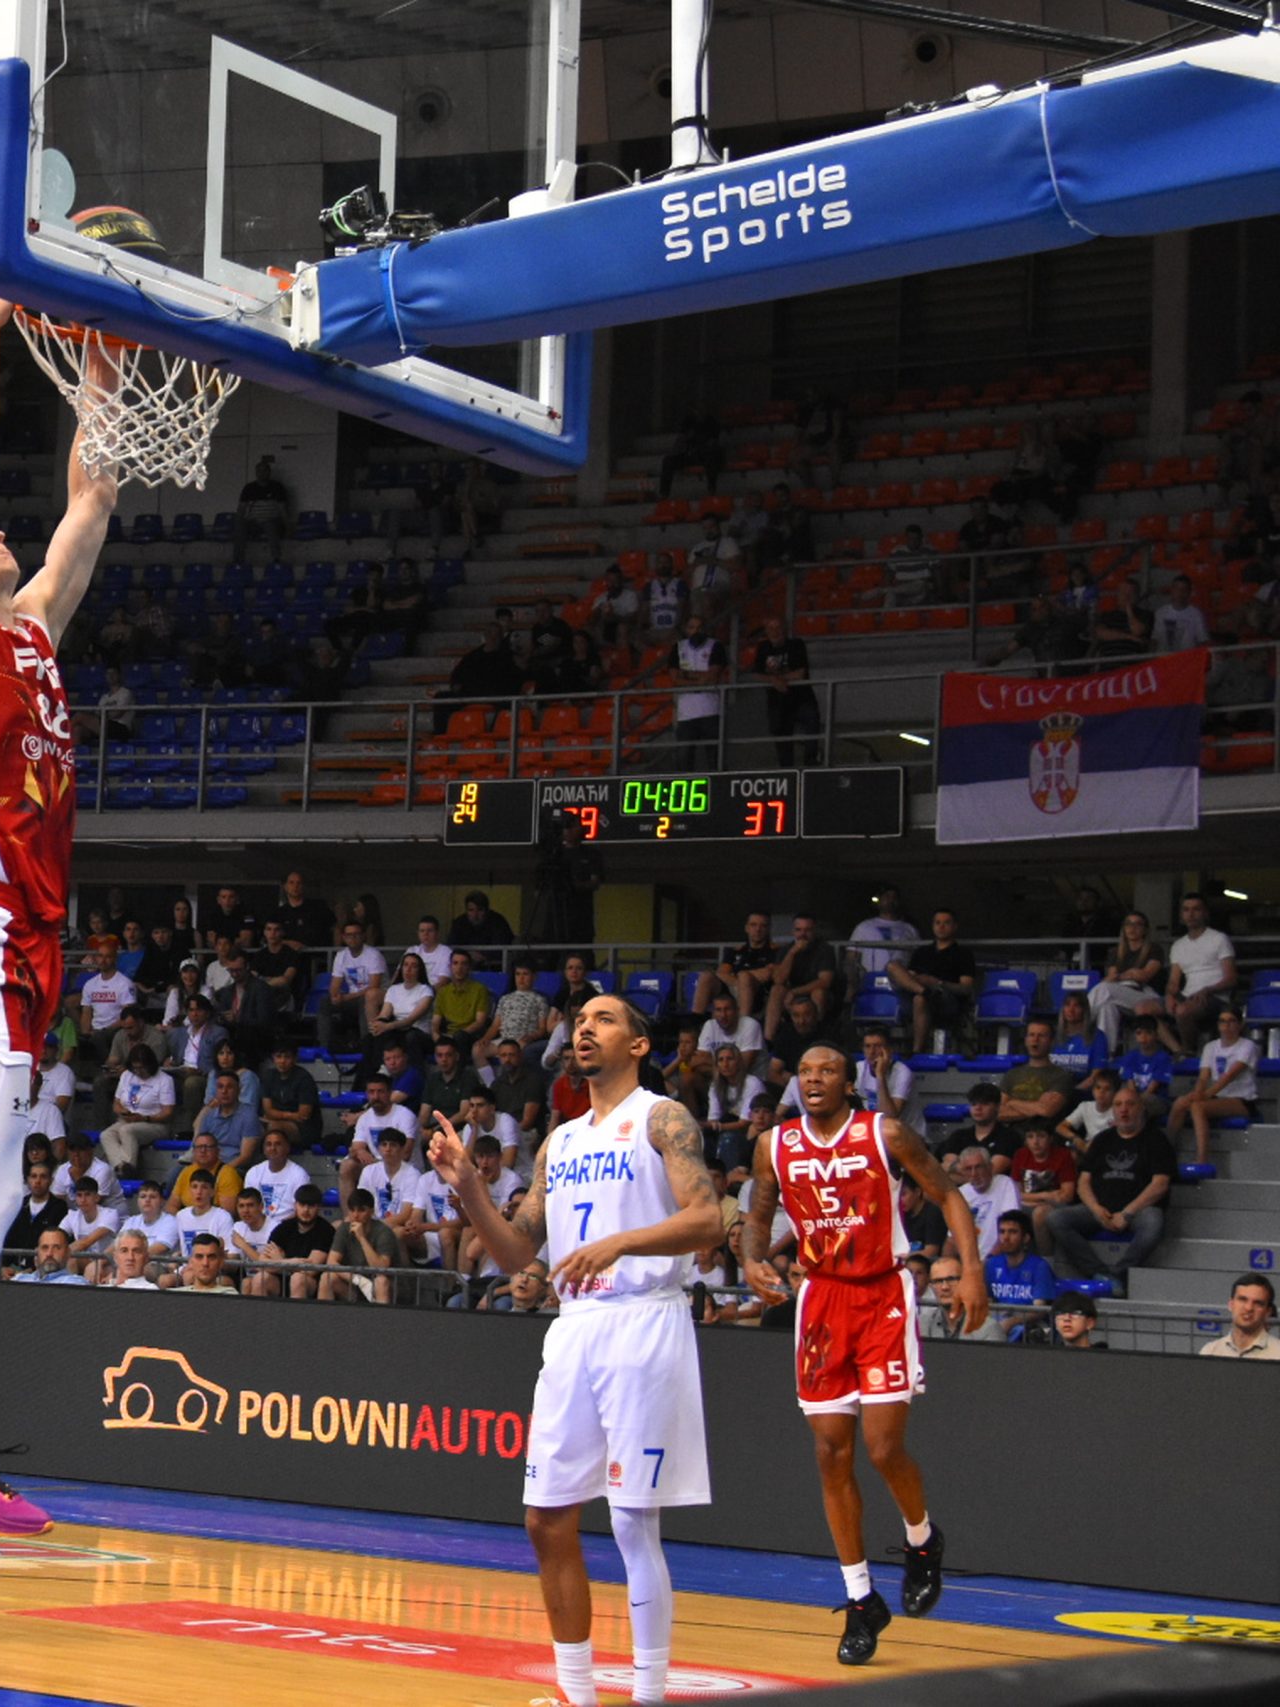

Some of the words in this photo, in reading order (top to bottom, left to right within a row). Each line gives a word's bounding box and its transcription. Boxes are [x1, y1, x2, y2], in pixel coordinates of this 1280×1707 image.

[662, 164, 847, 225] Schelde
[664, 200, 852, 263] Sports
[460, 783, 478, 803] 19
[542, 784, 609, 807] ДОМАЋИ
[623, 779, 708, 814] 04:06
[730, 778, 788, 797] ГОСТИ
[453, 803, 477, 823] 24
[656, 816, 670, 838] 2
[743, 800, 785, 836] 37
[545, 1150, 634, 1194] SPARTAK
[788, 1155, 868, 1183] FMP
[820, 1186, 840, 1213] 5
[573, 1202, 594, 1241] 7
[1254, 1251, 1269, 1269] 4
[887, 1361, 905, 1387] 5
[238, 1390, 532, 1459] POLOVNIAUTO
[642, 1447, 665, 1489] 7
